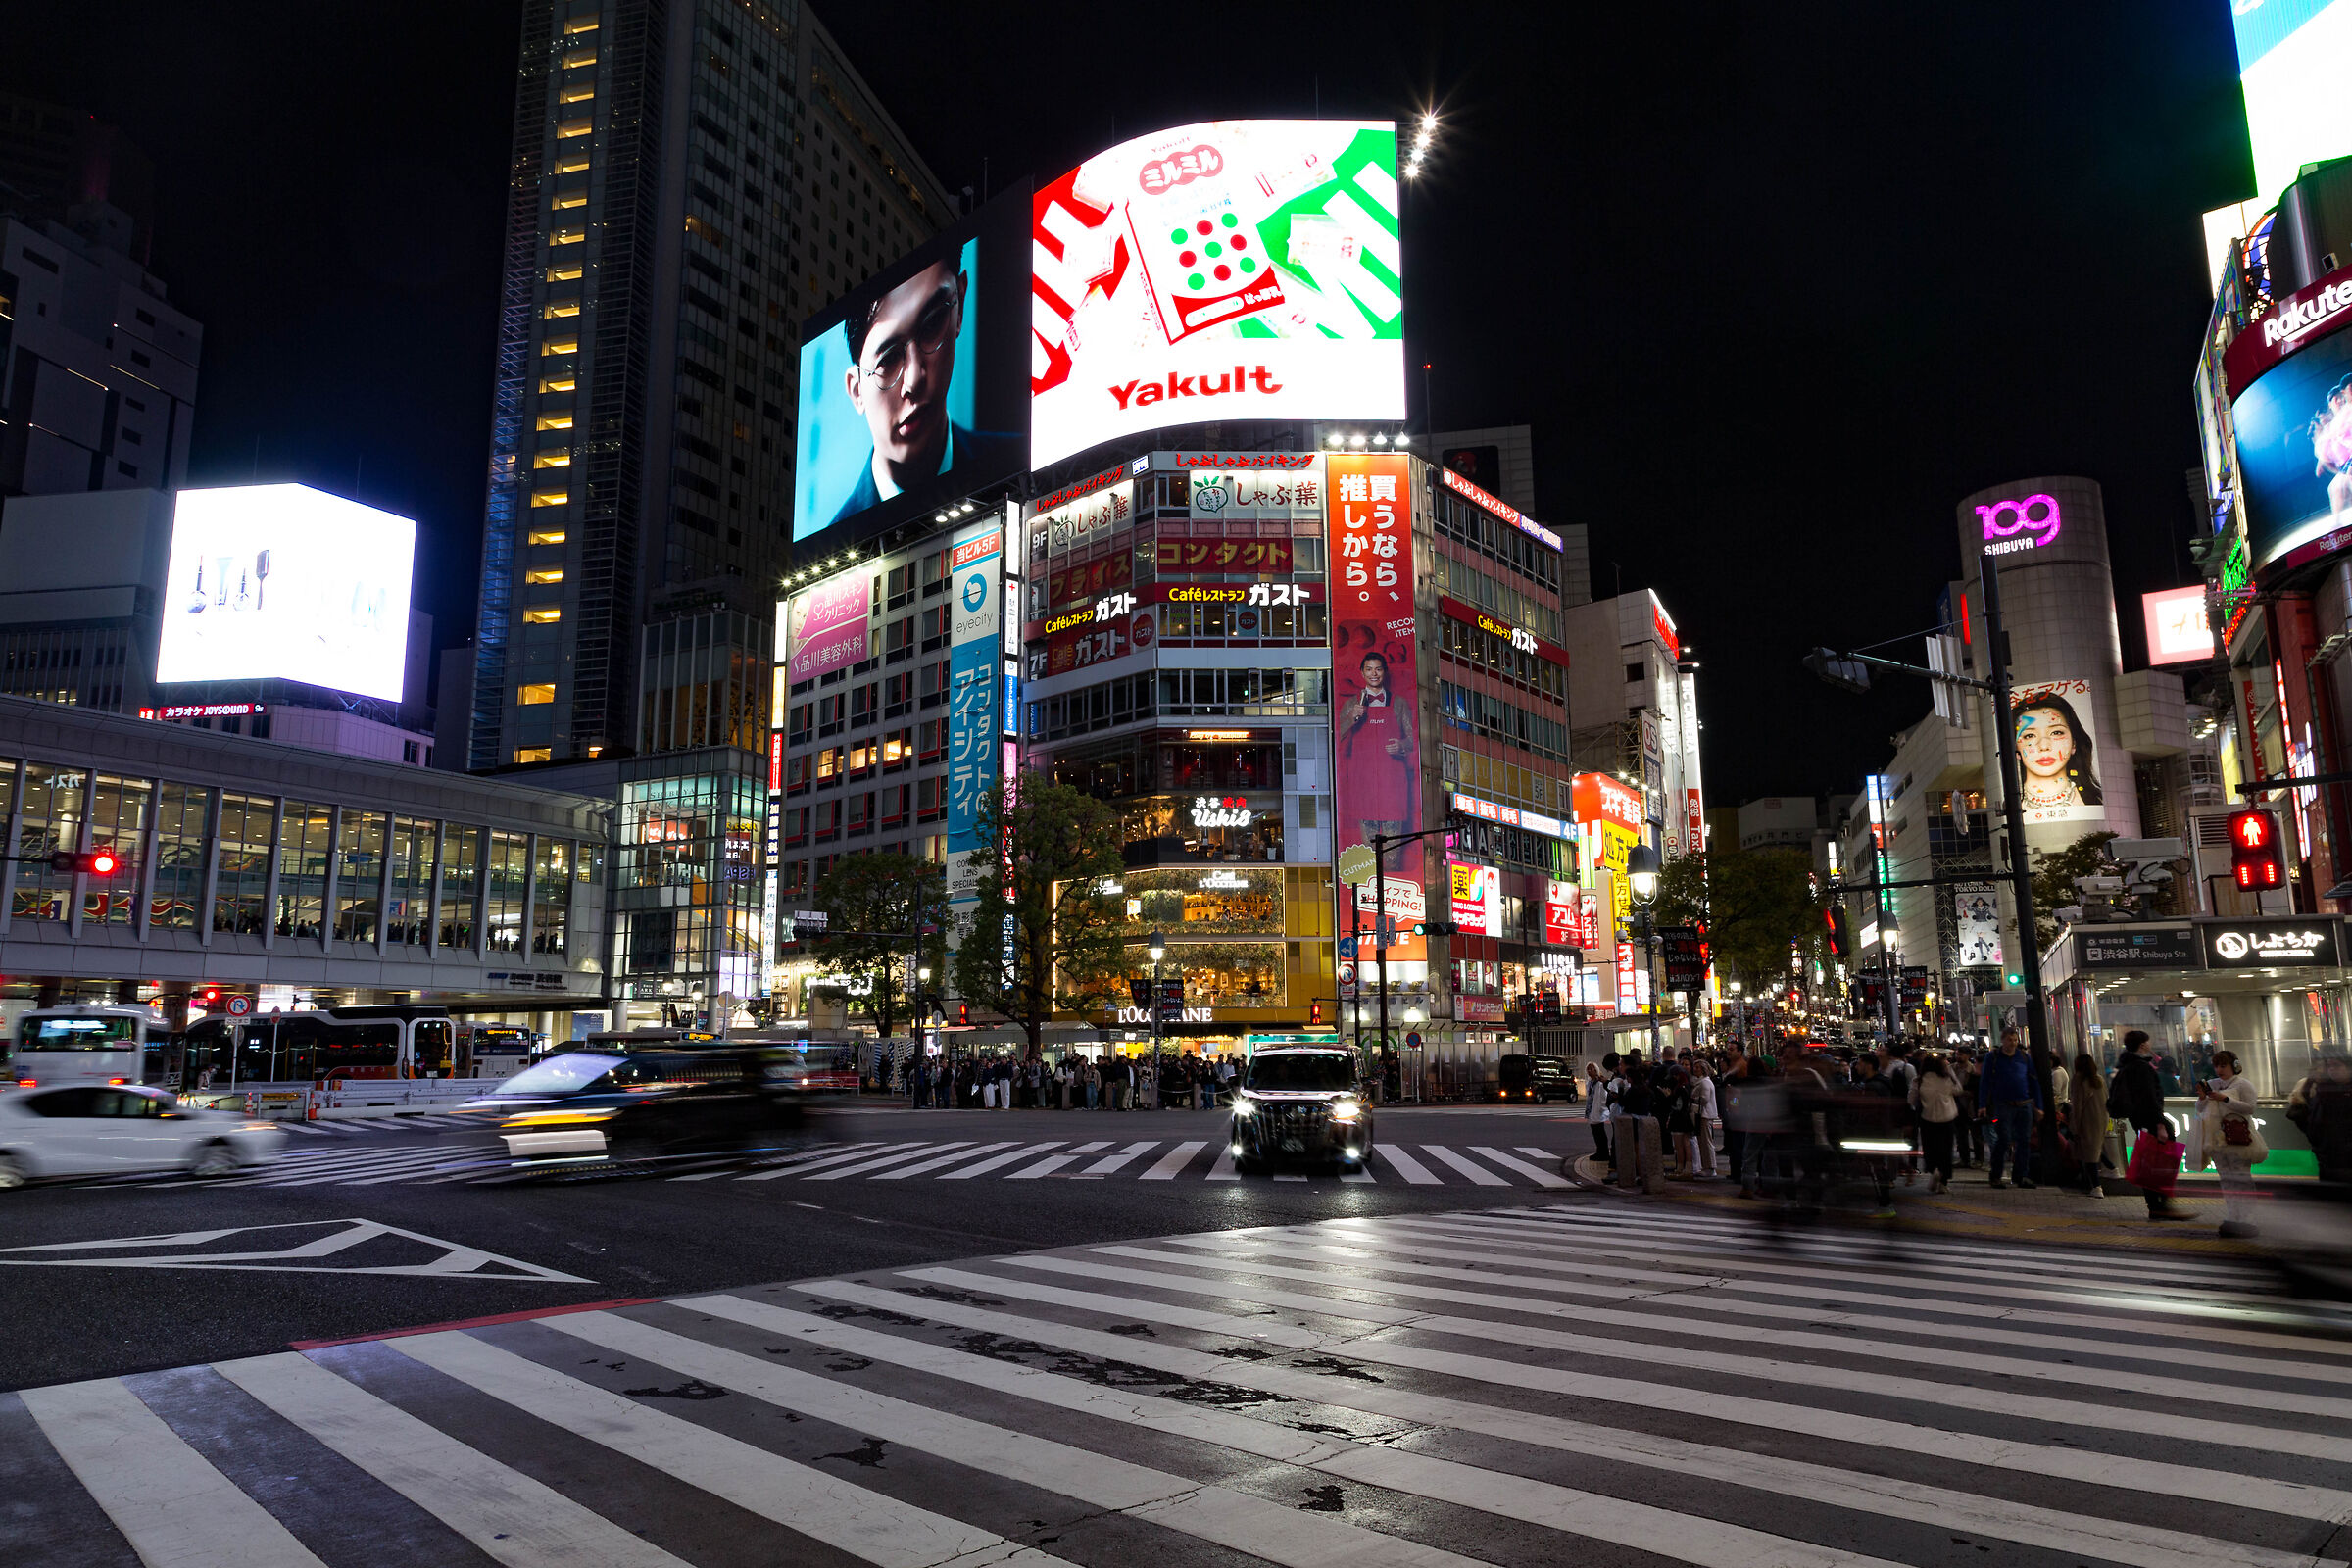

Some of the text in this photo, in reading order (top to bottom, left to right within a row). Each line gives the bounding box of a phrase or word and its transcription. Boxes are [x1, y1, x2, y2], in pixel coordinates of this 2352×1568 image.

[1143, 149, 1219, 188] ミルミル
[1108, 366, 1283, 411] Yakult
[1176, 453, 1315, 468] しゃぶしゃぶバイキング
[1036, 466, 1125, 513] しゃぶしゃぶバイキング
[1235, 480, 1318, 507] しゃぶ葉
[1452, 472, 1519, 523] しゃぶしゃぶバイキング
[1077, 496, 1129, 533] しゃぶ葉
[1975, 493, 2062, 547] 109
[956, 535, 996, 564] 当ビル5F
[1032, 531, 1048, 549] 9F
[1339, 474, 1370, 602] 推しから。
[1369, 474, 1399, 602] 買うなら、
[1984, 537, 2034, 556] SHIBUYA
[1157, 541, 1293, 566] コンタクト
[824, 580, 865, 609] 品川スキン
[1095, 591, 1137, 623] ガスト
[1249, 583, 1310, 607] ガスト
[824, 598, 860, 623] クリニック
[956, 612, 994, 635] eyecity
[800, 634, 863, 674] 品川美容外科
[1074, 628, 1126, 667] ガスト
[1511, 627, 1539, 656] ガスト
[1029, 652, 1048, 673] 7F
[165, 707, 203, 717] カラオケ
[203, 705, 250, 715] JOYSOUND
[954, 668, 974, 816] アイシティ
[974, 663, 992, 813] コンタクトの
[1644, 722, 1657, 754] OS
[1190, 808, 1252, 828] Ushi8
[1600, 785, 1642, 827] スギ薬局
[1562, 822, 1577, 841] 4F
[962, 867, 979, 878] LENS
[1453, 868, 1468, 897] 薬
[1360, 893, 1422, 911] SHPPING!
[1953, 884, 1978, 893] TOKYO
[1452, 911, 1486, 928] サンドラッグ
[1551, 906, 1576, 926] アコム
[1541, 952, 1576, 976] LUSH
[2103, 947, 2189, 960] 渋谷駅 Shibuya Sta.
[1477, 1002, 1503, 1013] サンドラッグ
